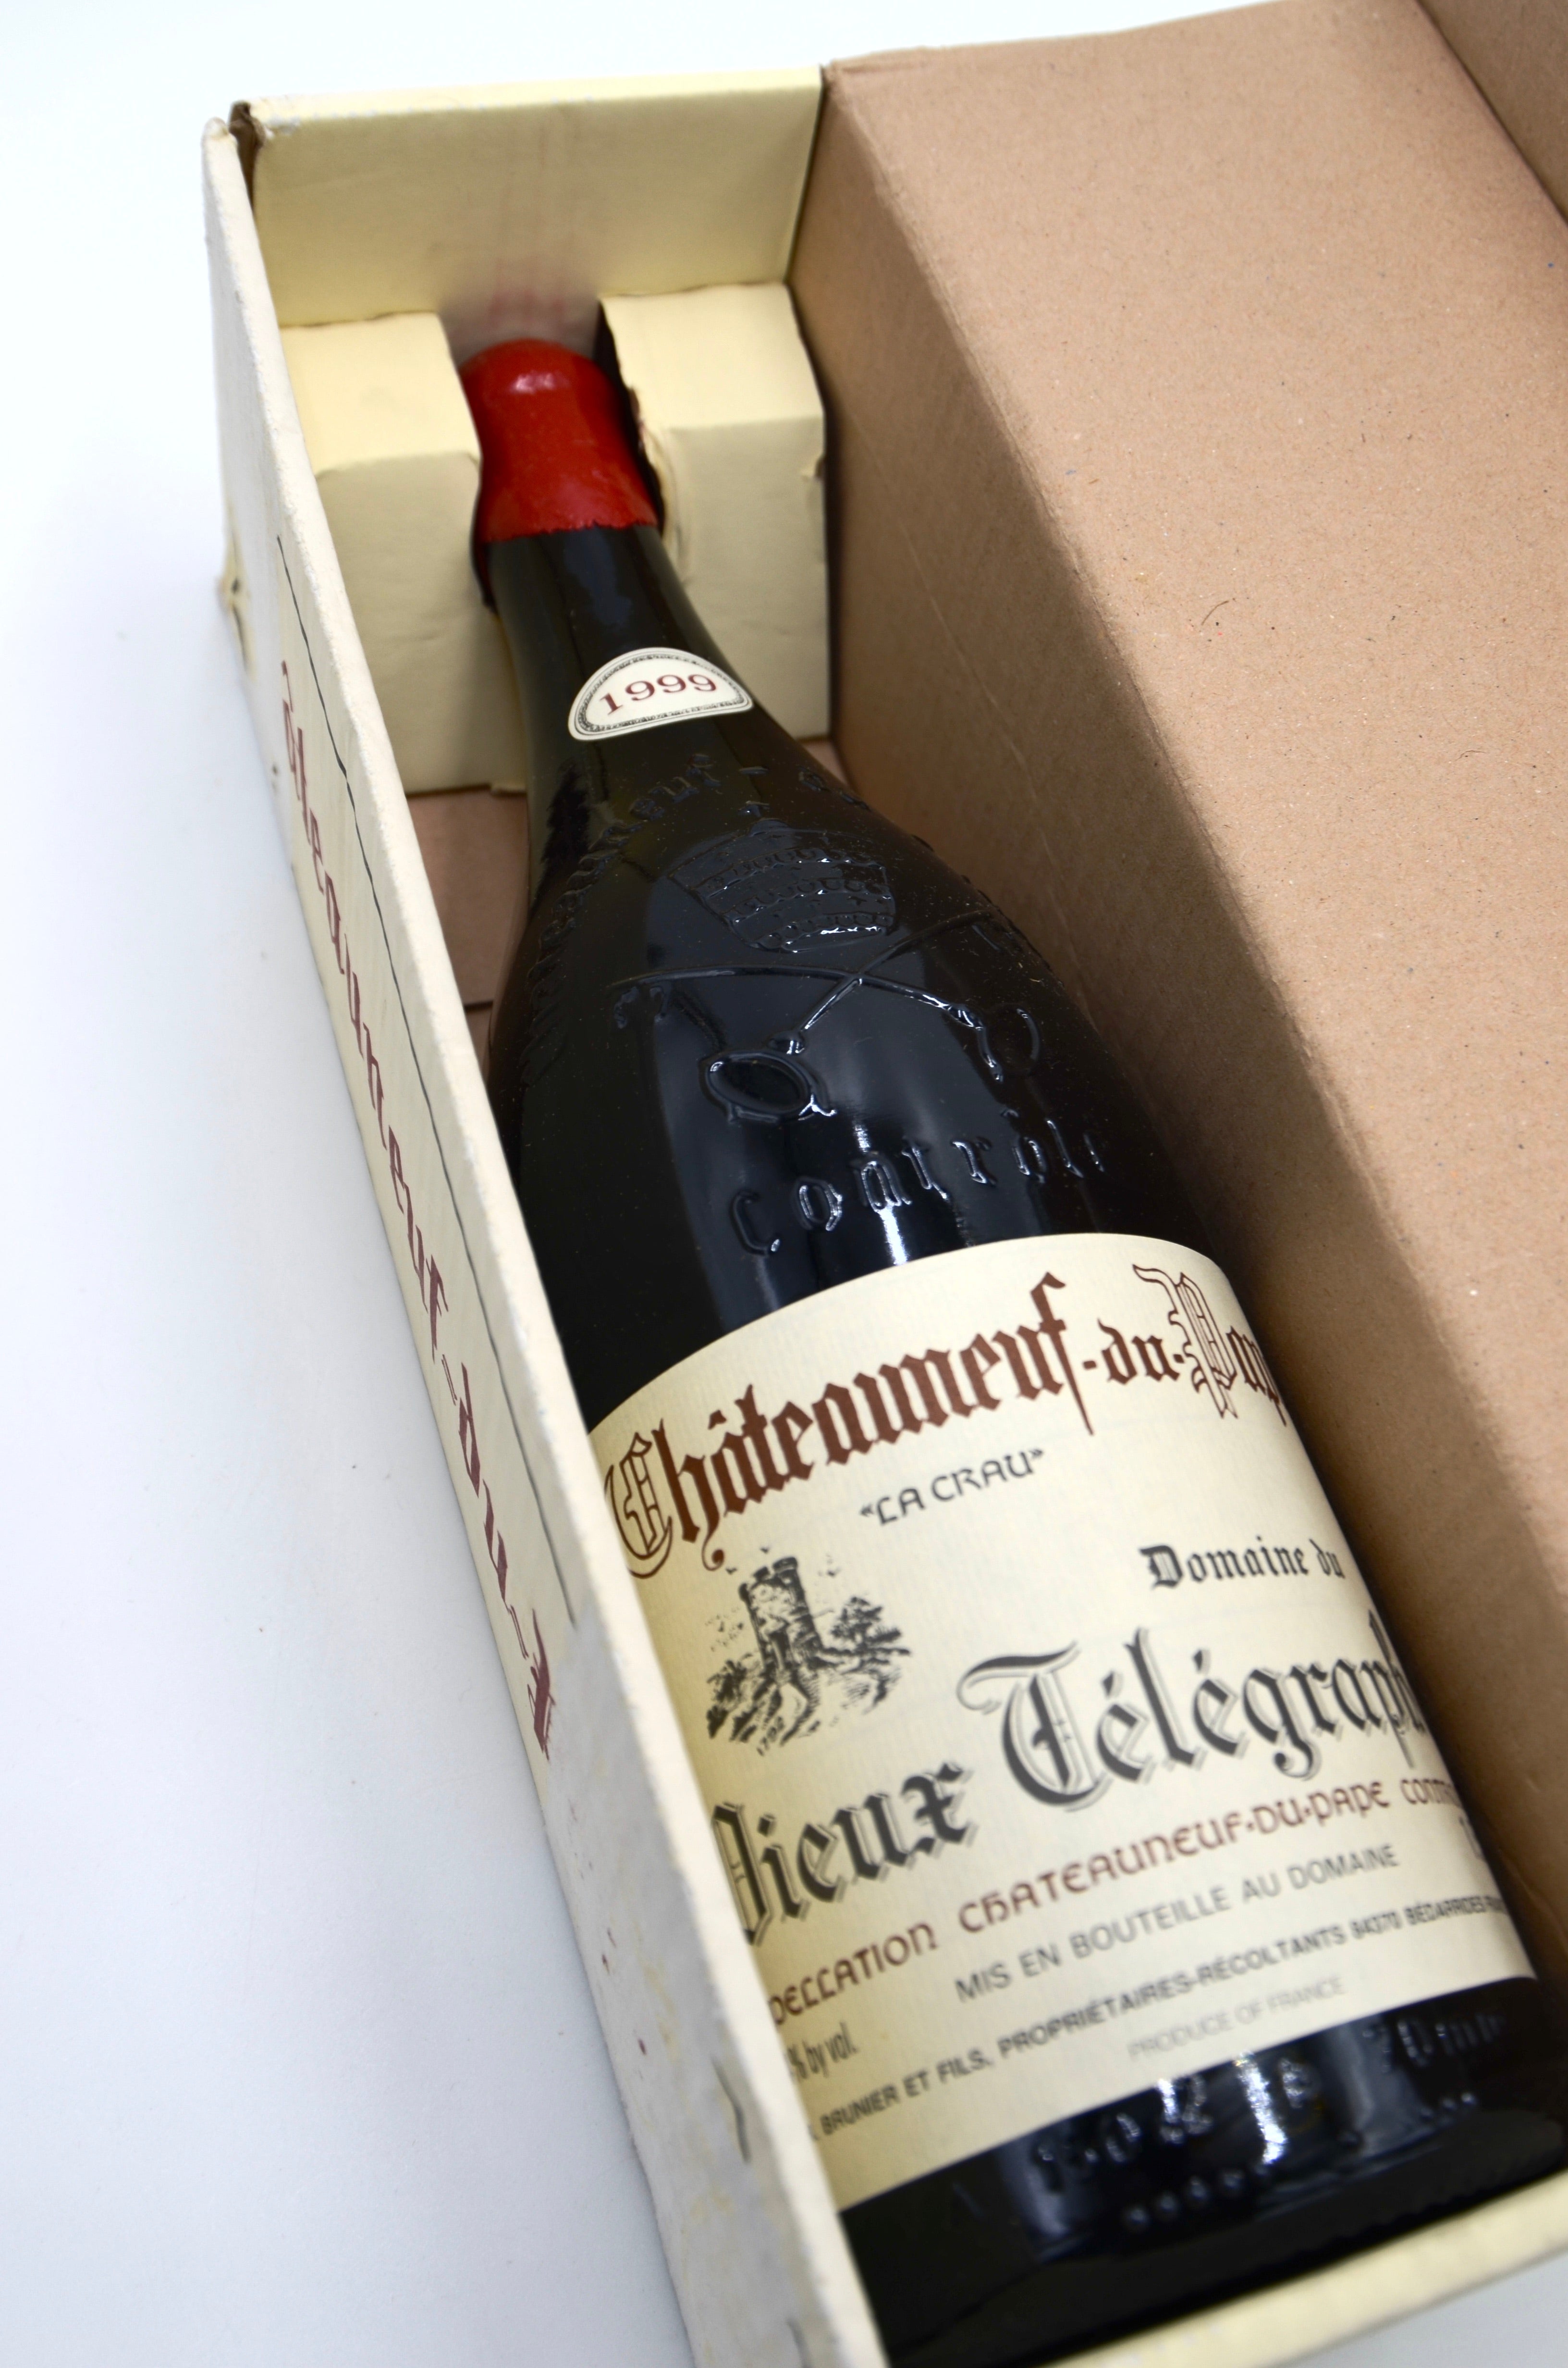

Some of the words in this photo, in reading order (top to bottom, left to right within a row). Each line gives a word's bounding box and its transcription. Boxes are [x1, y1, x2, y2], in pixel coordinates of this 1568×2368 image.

[600, 674, 717, 715] 1999
[1139, 1536, 1310, 1589] Domaine
[1309, 1539, 1346, 1579] du
[955, 1608, 1428, 1814] Télégraph
[955, 1961, 1013, 2004] MIS
[1018, 1943, 1062, 1979] EN
[1069, 1887, 1232, 1960] BOUTEILLE
[1241, 1873, 1281, 1904] AU
[1288, 1843, 1400, 1891] DOMAINE
[1127, 2012, 1233, 2060] PRODUCE
[1234, 1999, 1265, 2026] OF
[1265, 1974, 1347, 2012] FRANCE
[820, 2084, 901, 2135] BRUNIER
[903, 2069, 930, 2098] ET
